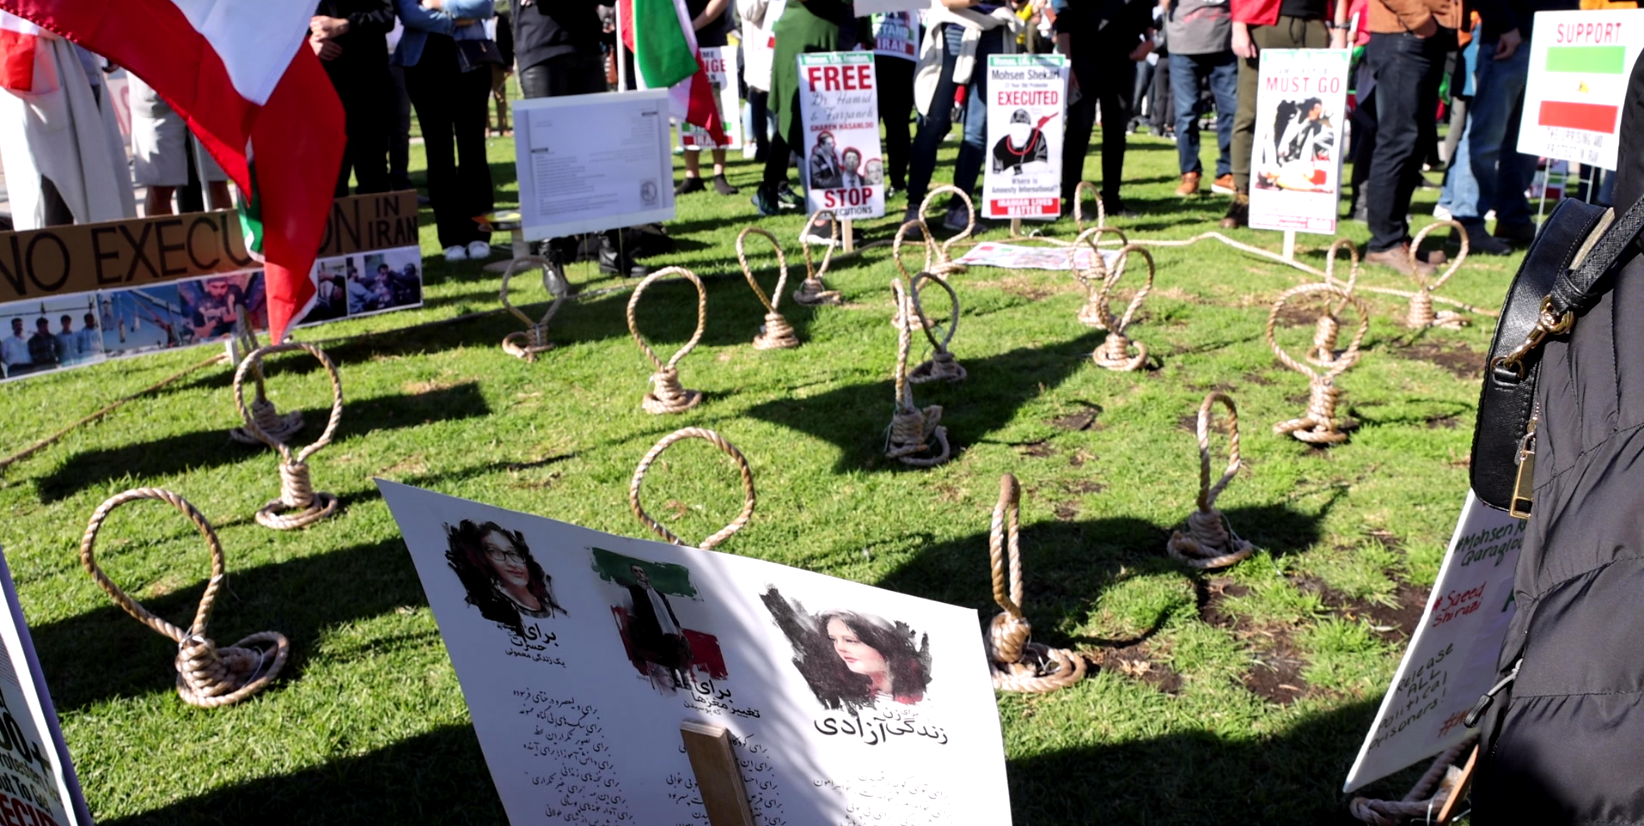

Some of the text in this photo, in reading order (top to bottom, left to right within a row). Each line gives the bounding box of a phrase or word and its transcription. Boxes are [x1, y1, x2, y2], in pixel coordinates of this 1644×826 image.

[1556, 22, 1622, 44] SUPPORT
[808, 64, 872, 92] FREE
[992, 69, 1025, 80] Mohsen
[1266, 76, 1340, 94] MUST GO
[836, 90, 873, 105] Hamid
[998, 91, 1059, 106] EXECUTED
[375, 195, 399, 218] IN
[824, 187, 873, 208] STOP
[368, 215, 418, 249] IRAN
[510, 635, 547, 651] حسرت
[524, 622, 559, 647] برای
[532, 653, 553, 665] زندگی
[695, 679, 733, 703] برای
[1408, 669, 1441, 698] ALL
[883, 707, 902, 722] زن
[814, 716, 948, 746] زندگی آزادی
[11, 775, 32, 802] To
